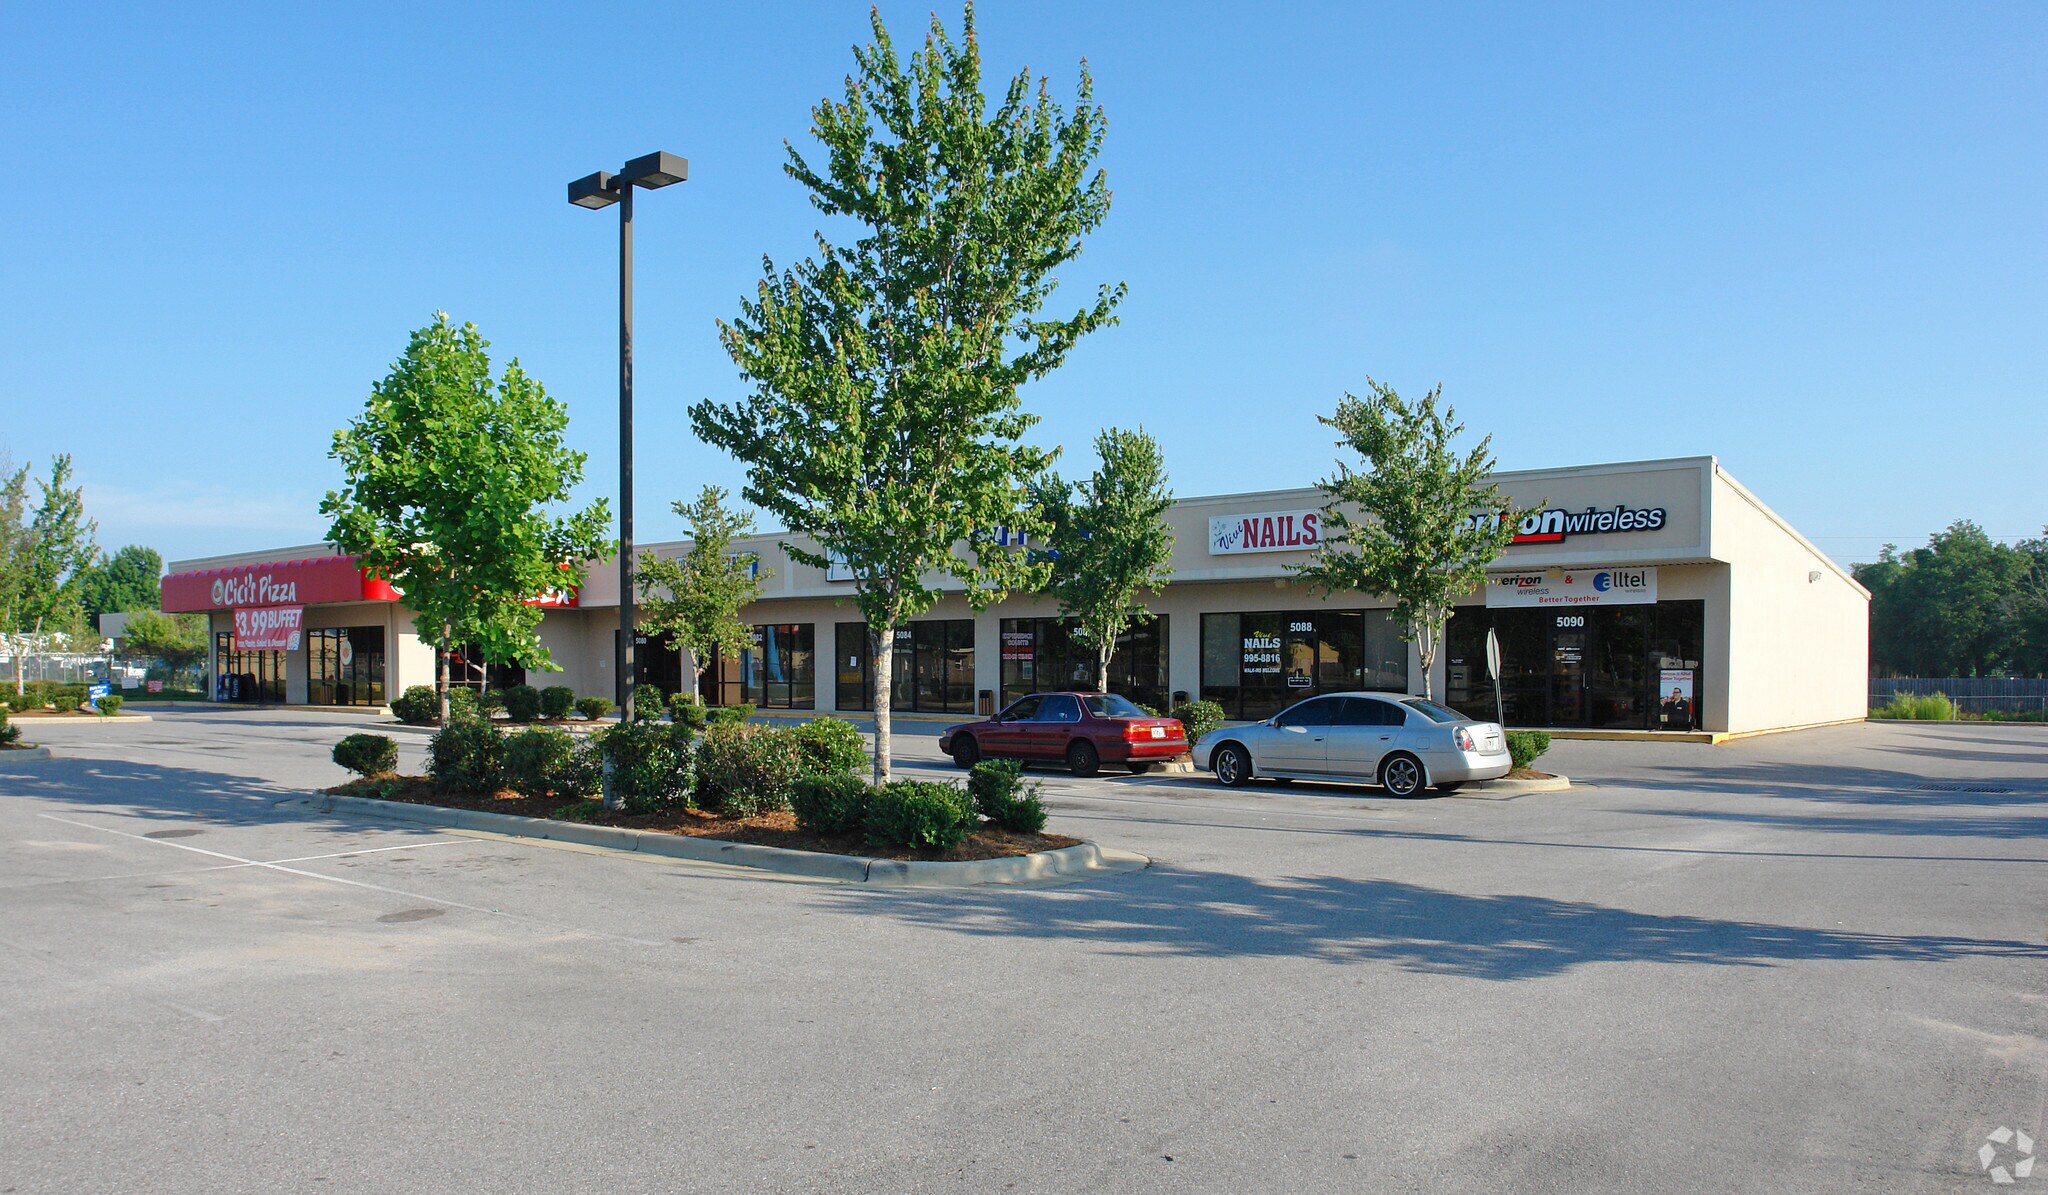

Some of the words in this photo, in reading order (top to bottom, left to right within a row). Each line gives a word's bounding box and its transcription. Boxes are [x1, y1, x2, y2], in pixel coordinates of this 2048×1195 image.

[1219, 521, 1244, 550] Vivi
[1243, 513, 1317, 549] NAILS
[1564, 575, 1573, 585] &
[1602, 571, 1647, 588] alltel
[1516, 588, 1550, 596] wireless
[1564, 595, 1600, 604] Together
[235, 610, 268, 637] $3.99
[267, 609, 303, 629] BUFFET
[1290, 622, 1313, 632] 5088
[1556, 616, 1584, 628] 5090
[896, 630, 912, 639] 5084
[1243, 637, 1281, 649] NAILS
[1243, 653, 1281, 663] 995-8816
